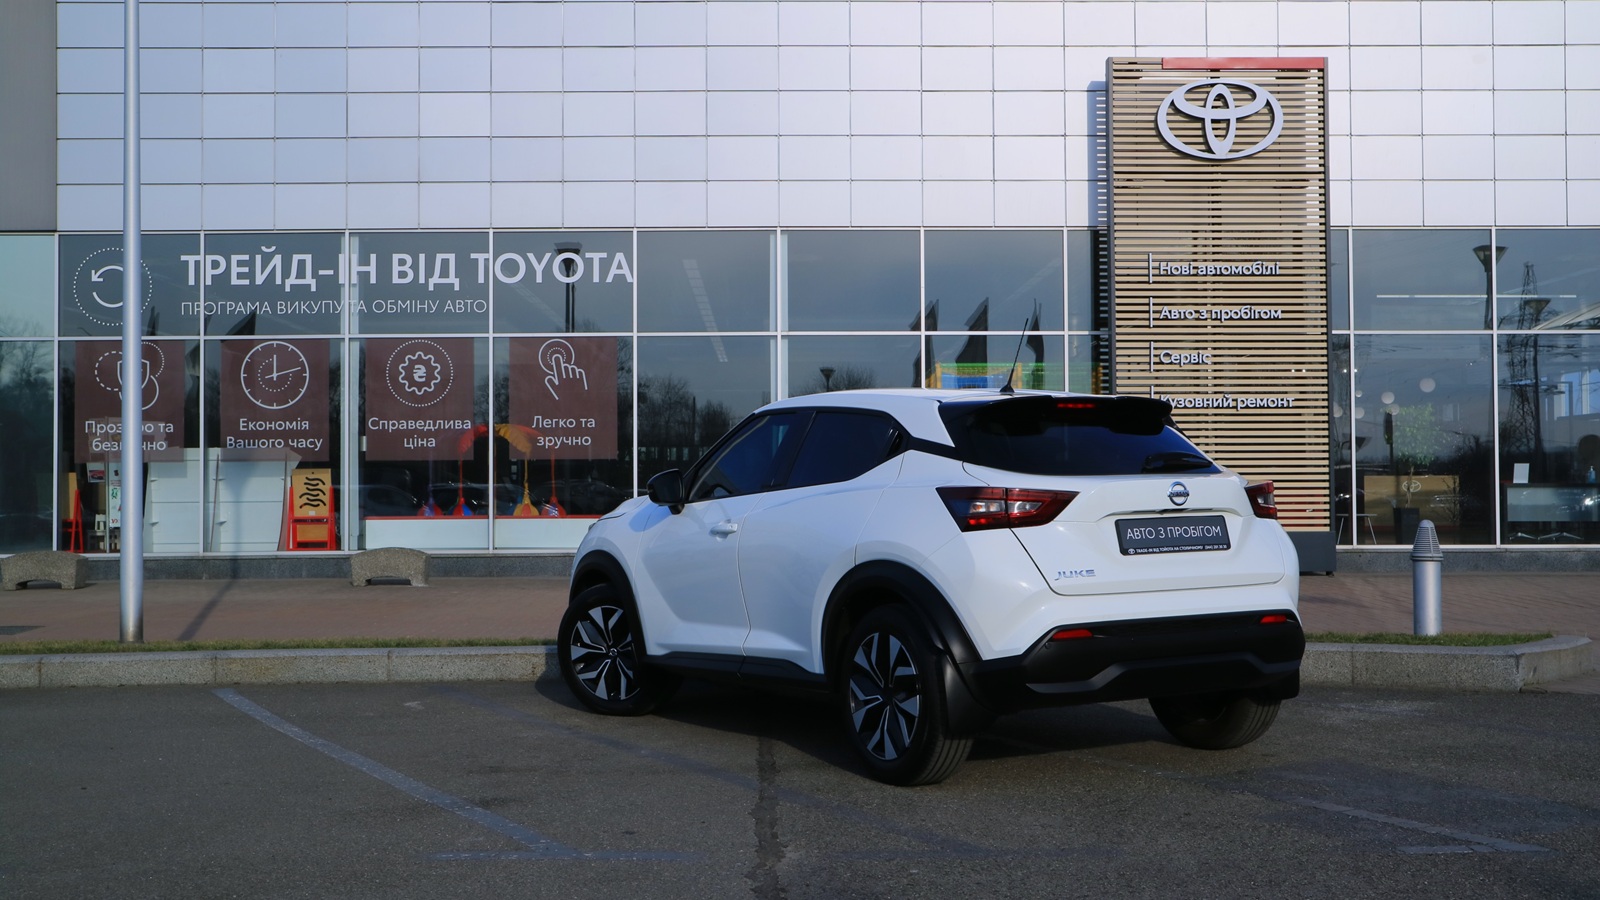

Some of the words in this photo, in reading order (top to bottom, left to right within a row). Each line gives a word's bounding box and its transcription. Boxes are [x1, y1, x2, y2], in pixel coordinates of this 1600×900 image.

[180, 246, 377, 292] ТРЕЙД-ІН
[392, 253, 460, 291] ВІД
[470, 252, 634, 284] TOYOTA
[1160, 261, 1194, 275] Нові
[1197, 261, 1280, 275] автомобілі
[181, 302, 271, 315] ПРОГРАМА
[277, 301, 344, 314] ВИКУПУ
[348, 300, 367, 313] ТА
[372, 300, 439, 313] ОБМІНУ
[443, 300, 487, 313] АВТО
[1160, 306, 1196, 319] Авто
[1199, 309, 1207, 319] з
[1211, 305, 1281, 322] пробігом
[1160, 350, 1212, 367] Сервіс
[1237, 397, 1295, 411] ремонт
[158, 423, 174, 433] та
[239, 418, 309, 431] Економія
[368, 417, 472, 432] Справедлива
[532, 416, 576, 428] Легко
[579, 418, 596, 428] та
[226, 436, 285, 449] Вашого
[288, 438, 323, 451] часу
[403, 435, 436, 449] ціна
[536, 435, 591, 449] зручно
[1126, 527, 1156, 540] АВТО
[1167, 525, 1223, 538] ПРОБІГОМ
[1054, 569, 1096, 581] JUKE
